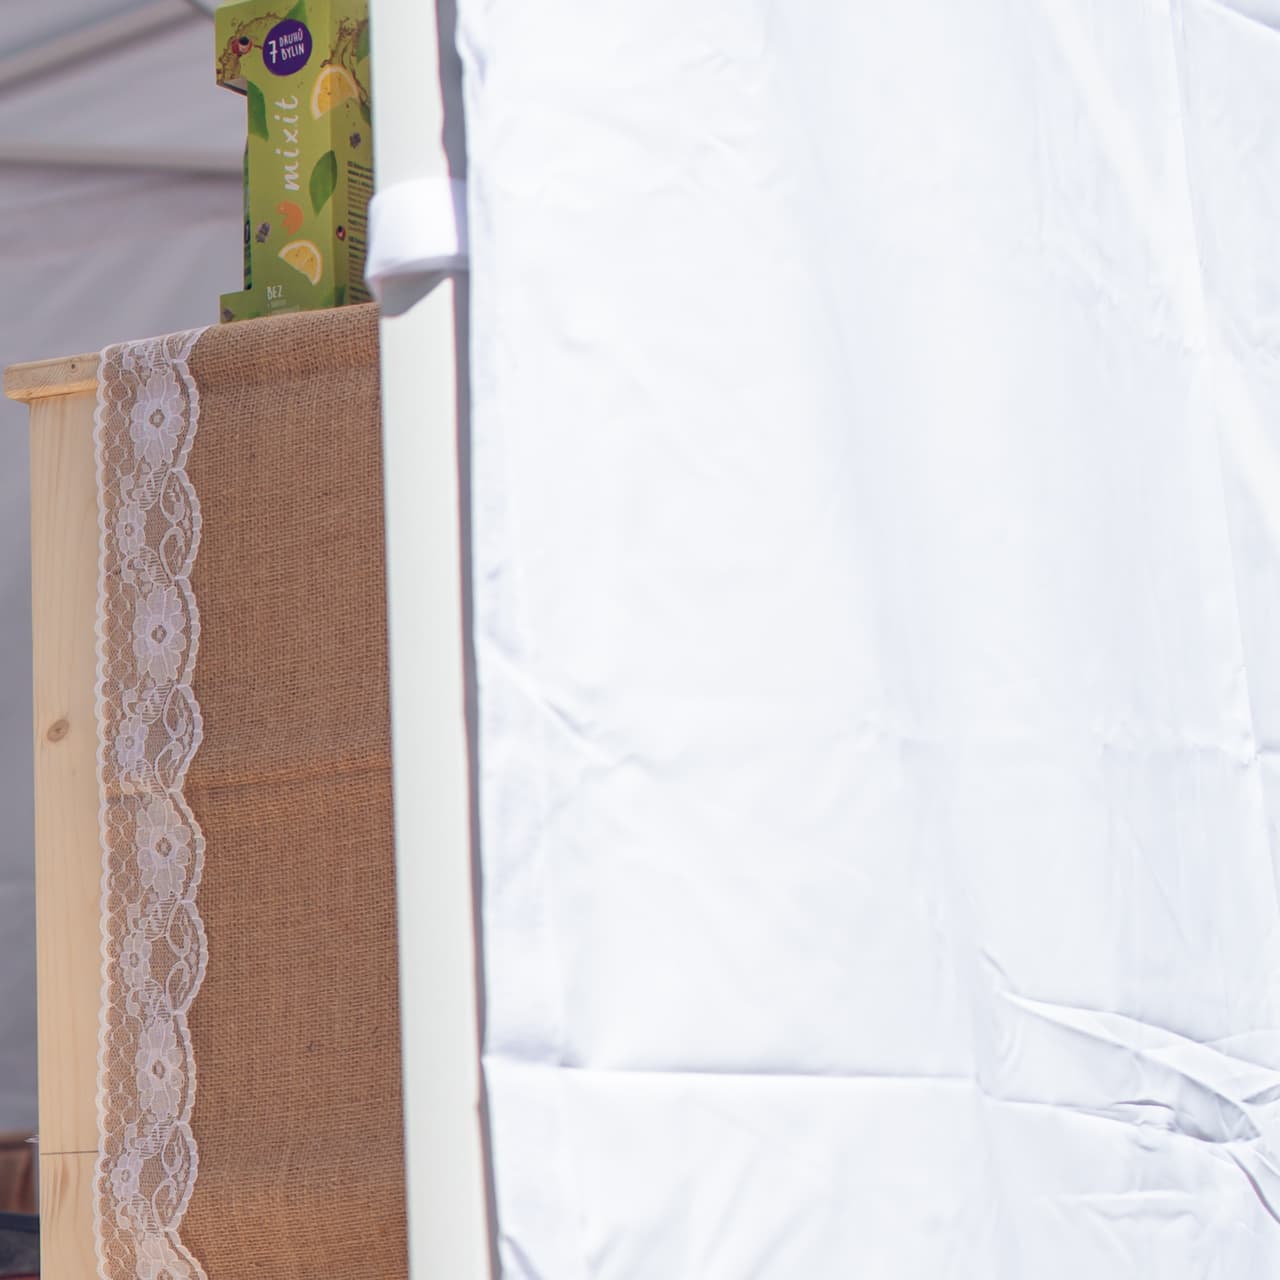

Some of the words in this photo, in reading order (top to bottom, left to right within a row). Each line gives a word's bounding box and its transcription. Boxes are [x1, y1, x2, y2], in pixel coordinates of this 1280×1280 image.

[268, 39, 278, 65] 7
[279, 27, 304, 48] DRUHŮ
[280, 42, 305, 61] BYLIN
[274, 95, 300, 191] mixit
